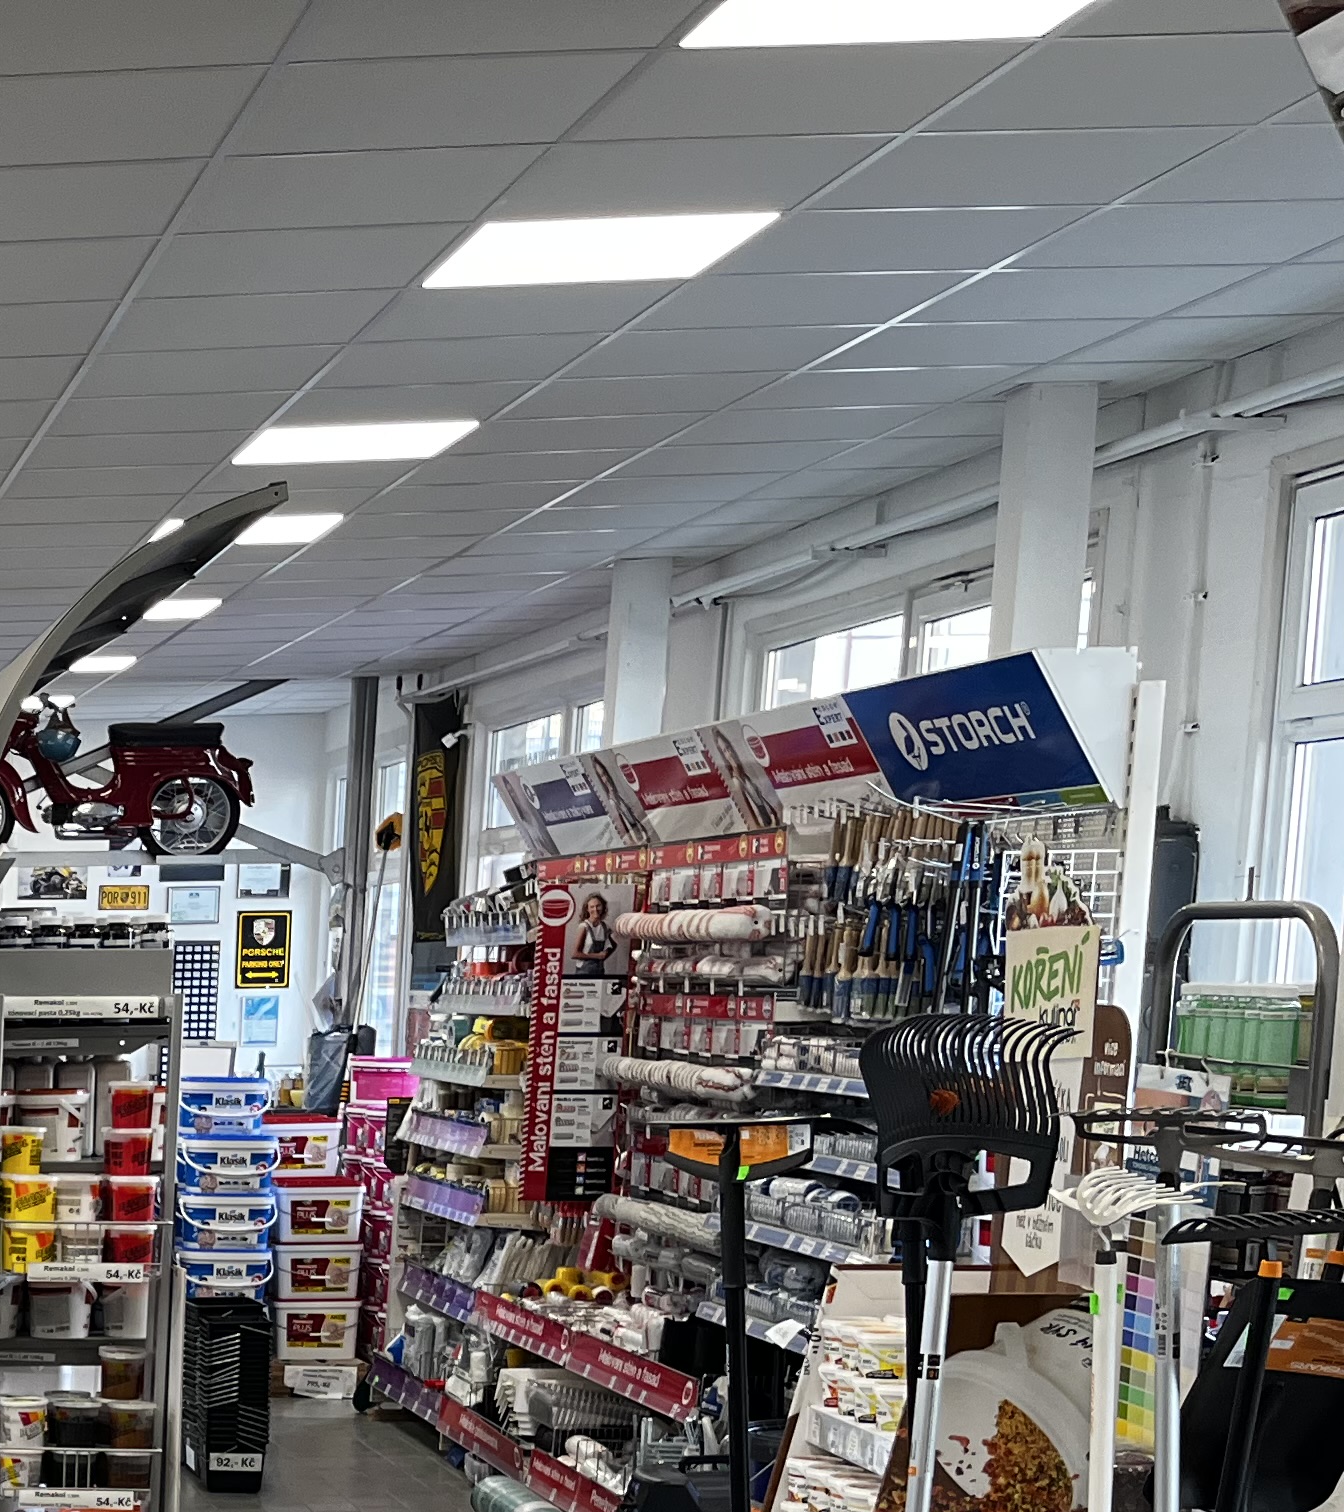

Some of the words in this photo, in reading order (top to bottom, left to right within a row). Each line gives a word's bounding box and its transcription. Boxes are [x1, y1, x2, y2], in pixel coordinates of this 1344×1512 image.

[920, 704, 1036, 756] STORCH
[101, 889, 119, 905] POR
[129, 889, 147, 905] 911
[242, 948, 284, 957] PORSCHE
[543, 947, 562, 1004] fasád
[1011, 931, 1091, 1013] KOŘENÍ
[113, 1002, 155, 1015] 54,-Kč
[543, 1012, 556, 1025] a
[537, 1034, 554, 1076] stěn
[215, 1096, 243, 1107] Klasik
[528, 1077, 552, 1172] Malování
[220, 1155, 248, 1167] Klasik
[218, 1211, 246, 1223] Klasik
[106, 1269, 142, 1280] 54,-Kč
[216, 1266, 244, 1278] Klasik
[96, 1496, 132, 1507] 54,-Kč
